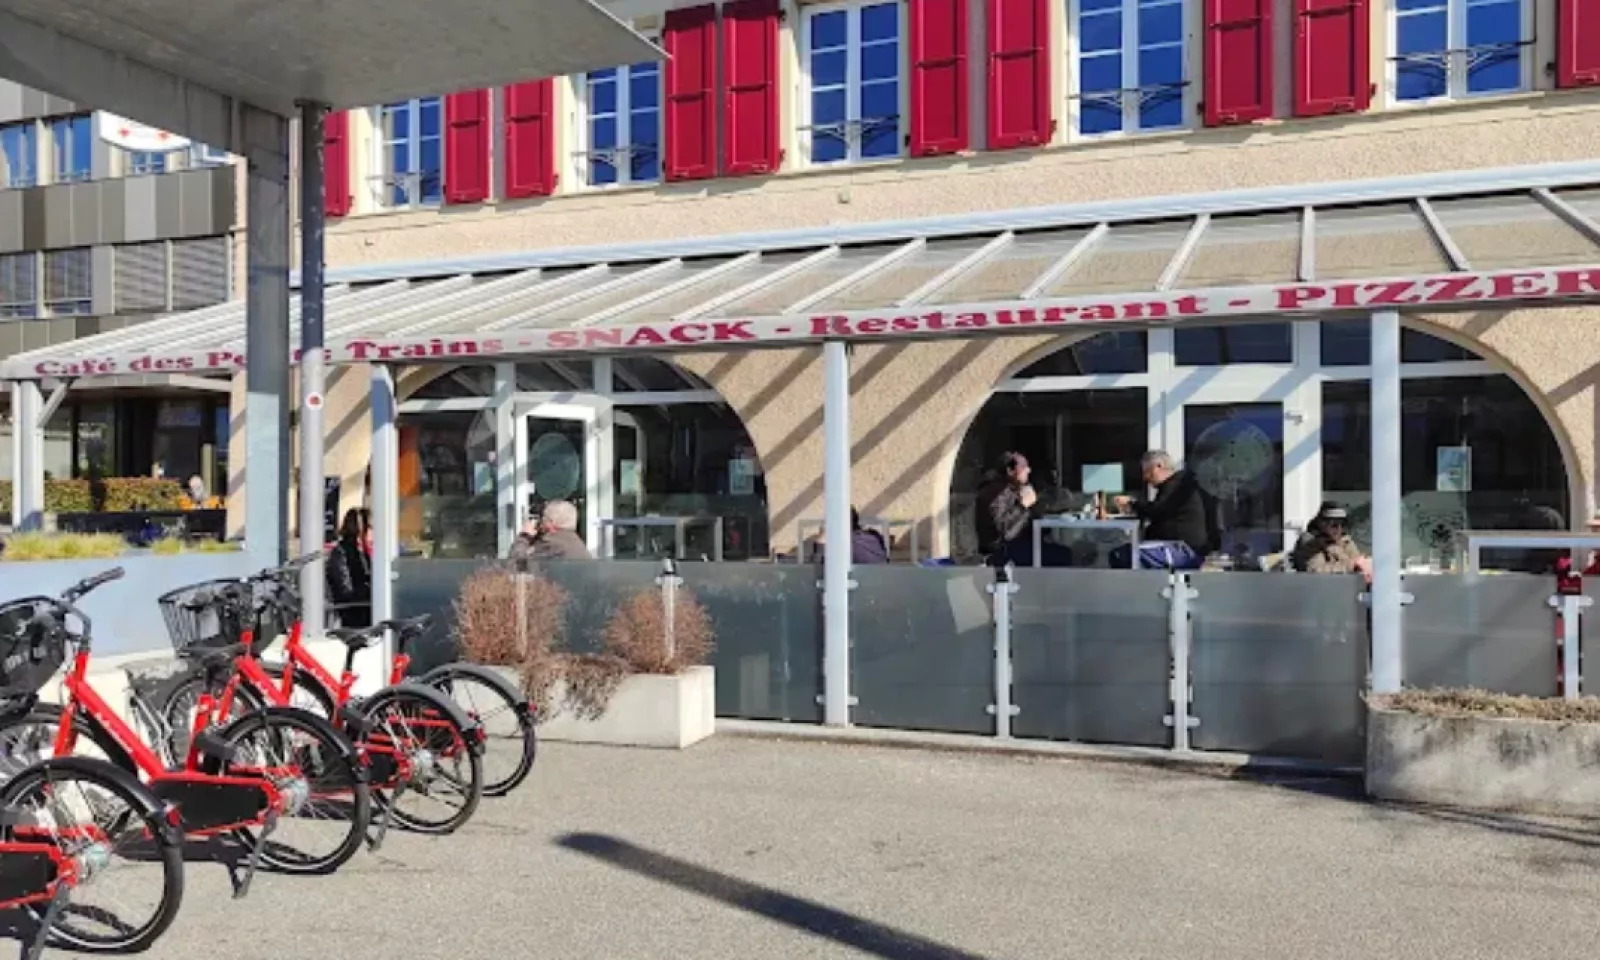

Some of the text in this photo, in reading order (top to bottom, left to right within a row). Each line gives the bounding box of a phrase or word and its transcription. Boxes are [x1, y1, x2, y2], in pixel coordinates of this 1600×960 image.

[35, 358, 116, 375] Café
[130, 355, 194, 373] des
[345, 337, 502, 360] Trains
[546, 320, 757, 348] SNACK
[809, 295, 1208, 336] Restaurant
